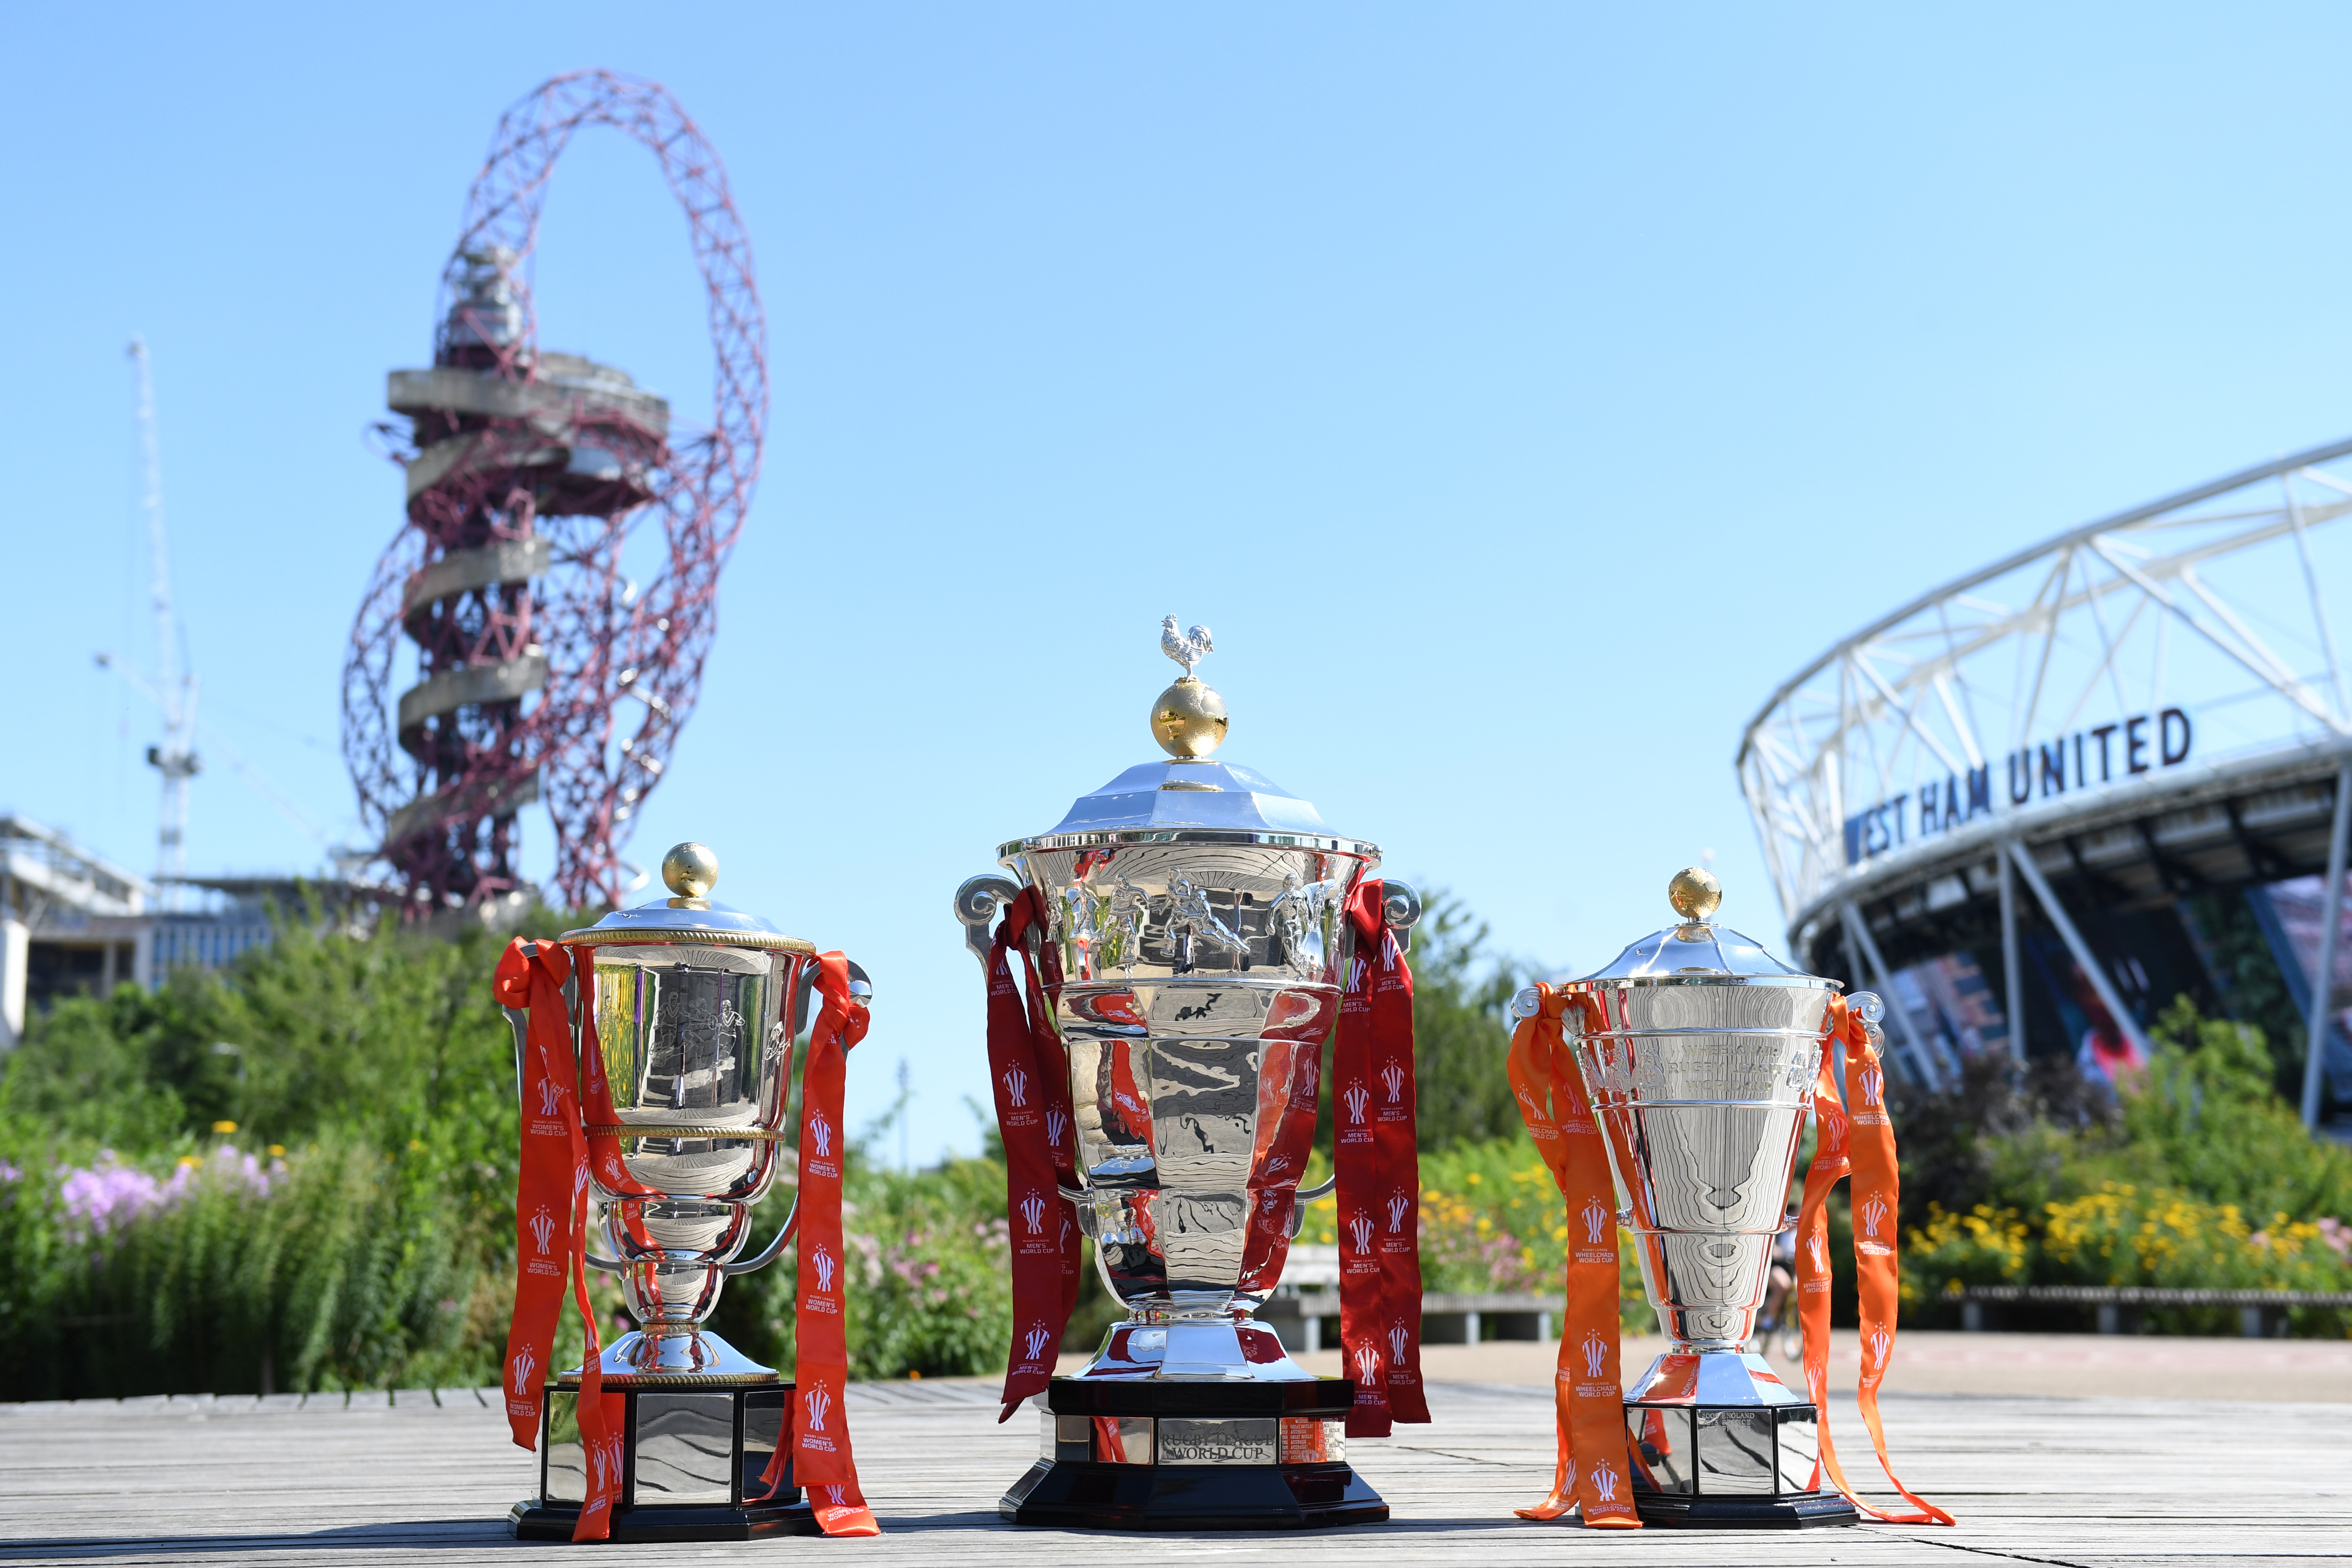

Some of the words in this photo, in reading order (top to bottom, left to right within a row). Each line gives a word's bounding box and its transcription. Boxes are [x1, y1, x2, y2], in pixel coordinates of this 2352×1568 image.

[1920, 763, 1991, 836] HAM
[2009, 708, 2191, 804] UNITED
[1682, 1045, 1779, 1056] WHEELCHAIR
[1668, 1062, 1724, 1073] RUGBY
[1731, 1062, 1787, 1074] LEAGUE
[1686, 1080, 1742, 1092] WORLD
[1745, 1081, 1773, 1092] CUP
[808, 1168, 826, 1176] WORLD
[810, 1163, 836, 1172] WOMEN'S
[530, 1262, 557, 1271] WOMEN'S
[806, 1304, 825, 1312] WORLD
[808, 1298, 835, 1308] WOMEN'S
[803, 1437, 833, 1447] WOMEN'S
[1161, 1434, 1209, 1446] RUGBY
[1215, 1434, 1274, 1446] LEAGUE
[802, 1443, 823, 1451] WORLD
[1172, 1447, 1228, 1459] WORLD
[1232, 1447, 1263, 1459] CUP
[827, 1512, 850, 1521] WORLD
[828, 1508, 860, 1518] WOMEN'S
